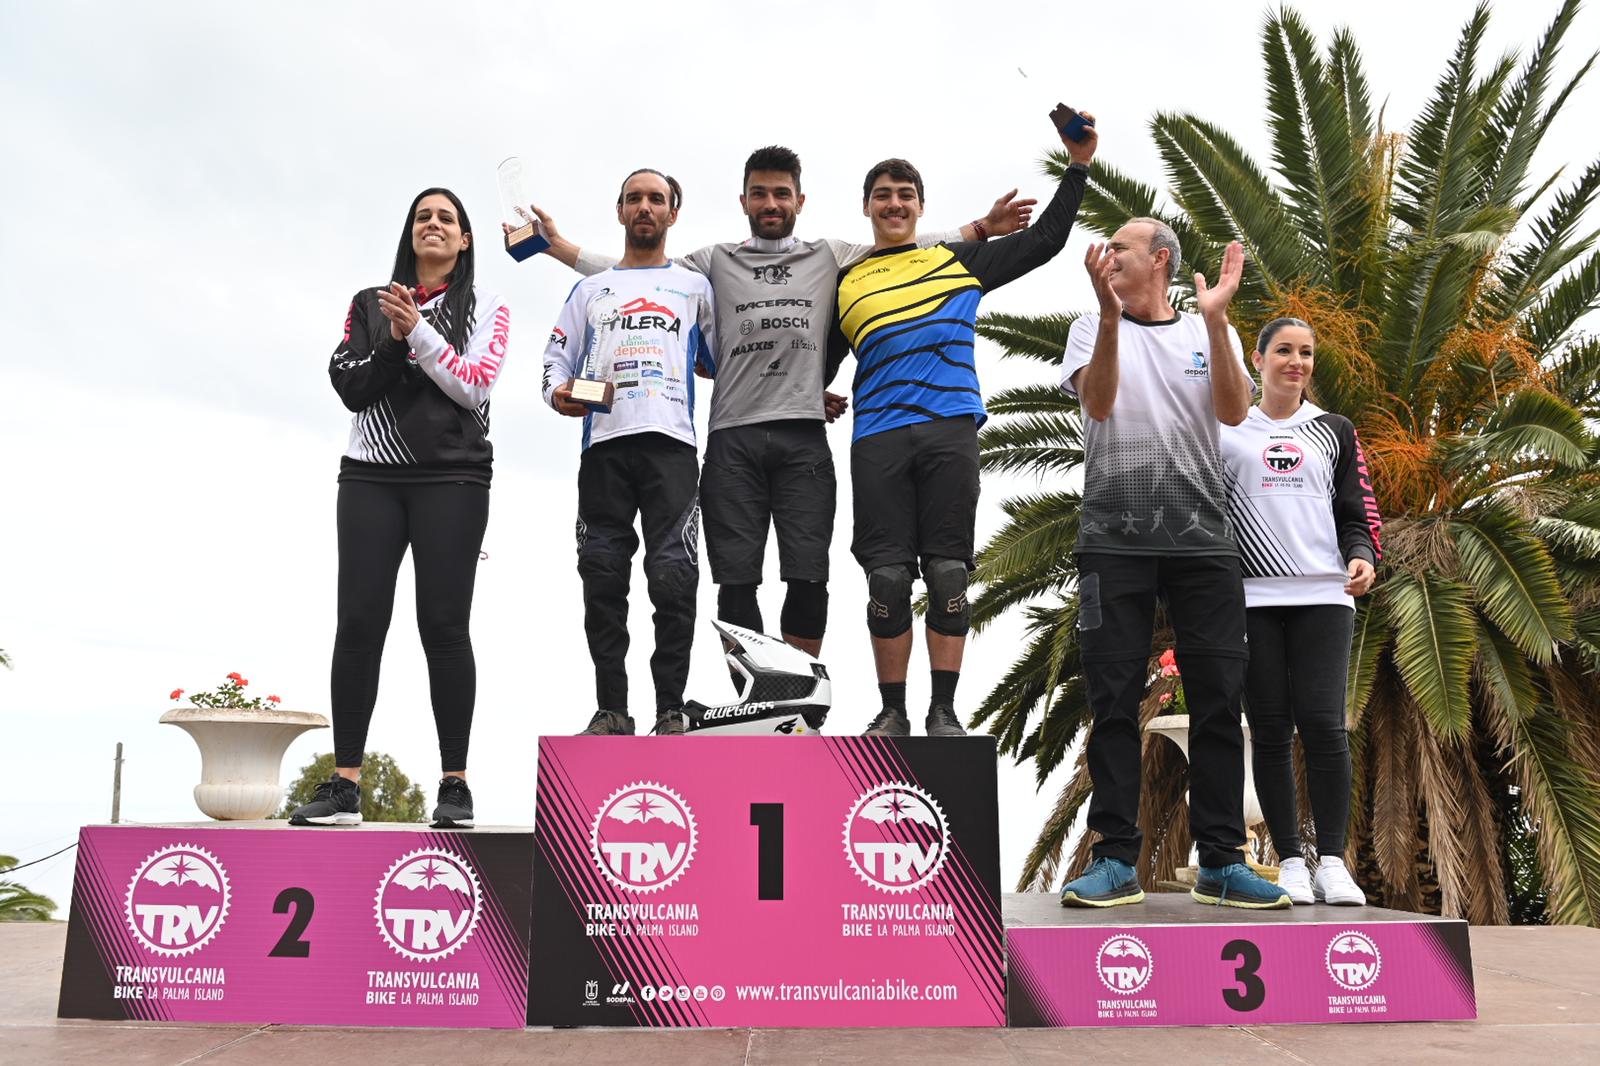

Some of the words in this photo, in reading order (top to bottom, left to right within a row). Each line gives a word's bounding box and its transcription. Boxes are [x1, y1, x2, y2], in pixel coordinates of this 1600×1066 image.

[752, 264, 793, 285] FOX
[761, 317, 809, 330] BOSCH
[613, 345, 664, 358] deporte
[729, 341, 775, 358] MAXXIS
[1266, 457, 1300, 470] TRV
[749, 803, 784, 901] 1
[600, 842, 687, 883] TRV
[853, 842, 940, 883] TRV
[586, 903, 699, 921] TRANSVULCANIA
[841, 903, 955, 921] TRANSVULCANIA
[134, 904, 220, 946] TRV
[267, 887, 316, 959] 2
[384, 908, 471, 951] TRV
[586, 923, 616, 937] BIKE
[621, 924, 631, 937] LA
[636, 924, 664, 937] PALMA
[668, 924, 699, 937] ISLAND
[842, 923, 873, 937] BIKE
[877, 924, 888, 937] LA
[892, 924, 921, 937] PALMA
[924, 924, 955, 937] ISLAND
[115, 965, 226, 985] TRANSVULCANIA
[367, 970, 480, 990] TRANSVULCANIA
[1101, 966, 1148, 989] TRV
[1220, 939, 1266, 1013] 3
[1331, 962, 1377, 985] TRV
[113, 985, 144, 999] BIKE
[148, 986, 158, 1000] LA
[162, 987, 190, 1000] PALMA
[194, 987, 224, 1001] ISLAND
[365, 991, 397, 1005] BIKE
[401, 992, 412, 1005] LA
[415, 992, 444, 1006] PALMA
[448, 993, 479, 1006] ISLAND
[736, 979, 958, 1001] www.transvulcaniabike.com
[1097, 999, 1157, 1009] TRANSVULCANIA
[1328, 995, 1387, 1006] TRANSVULCANIA
